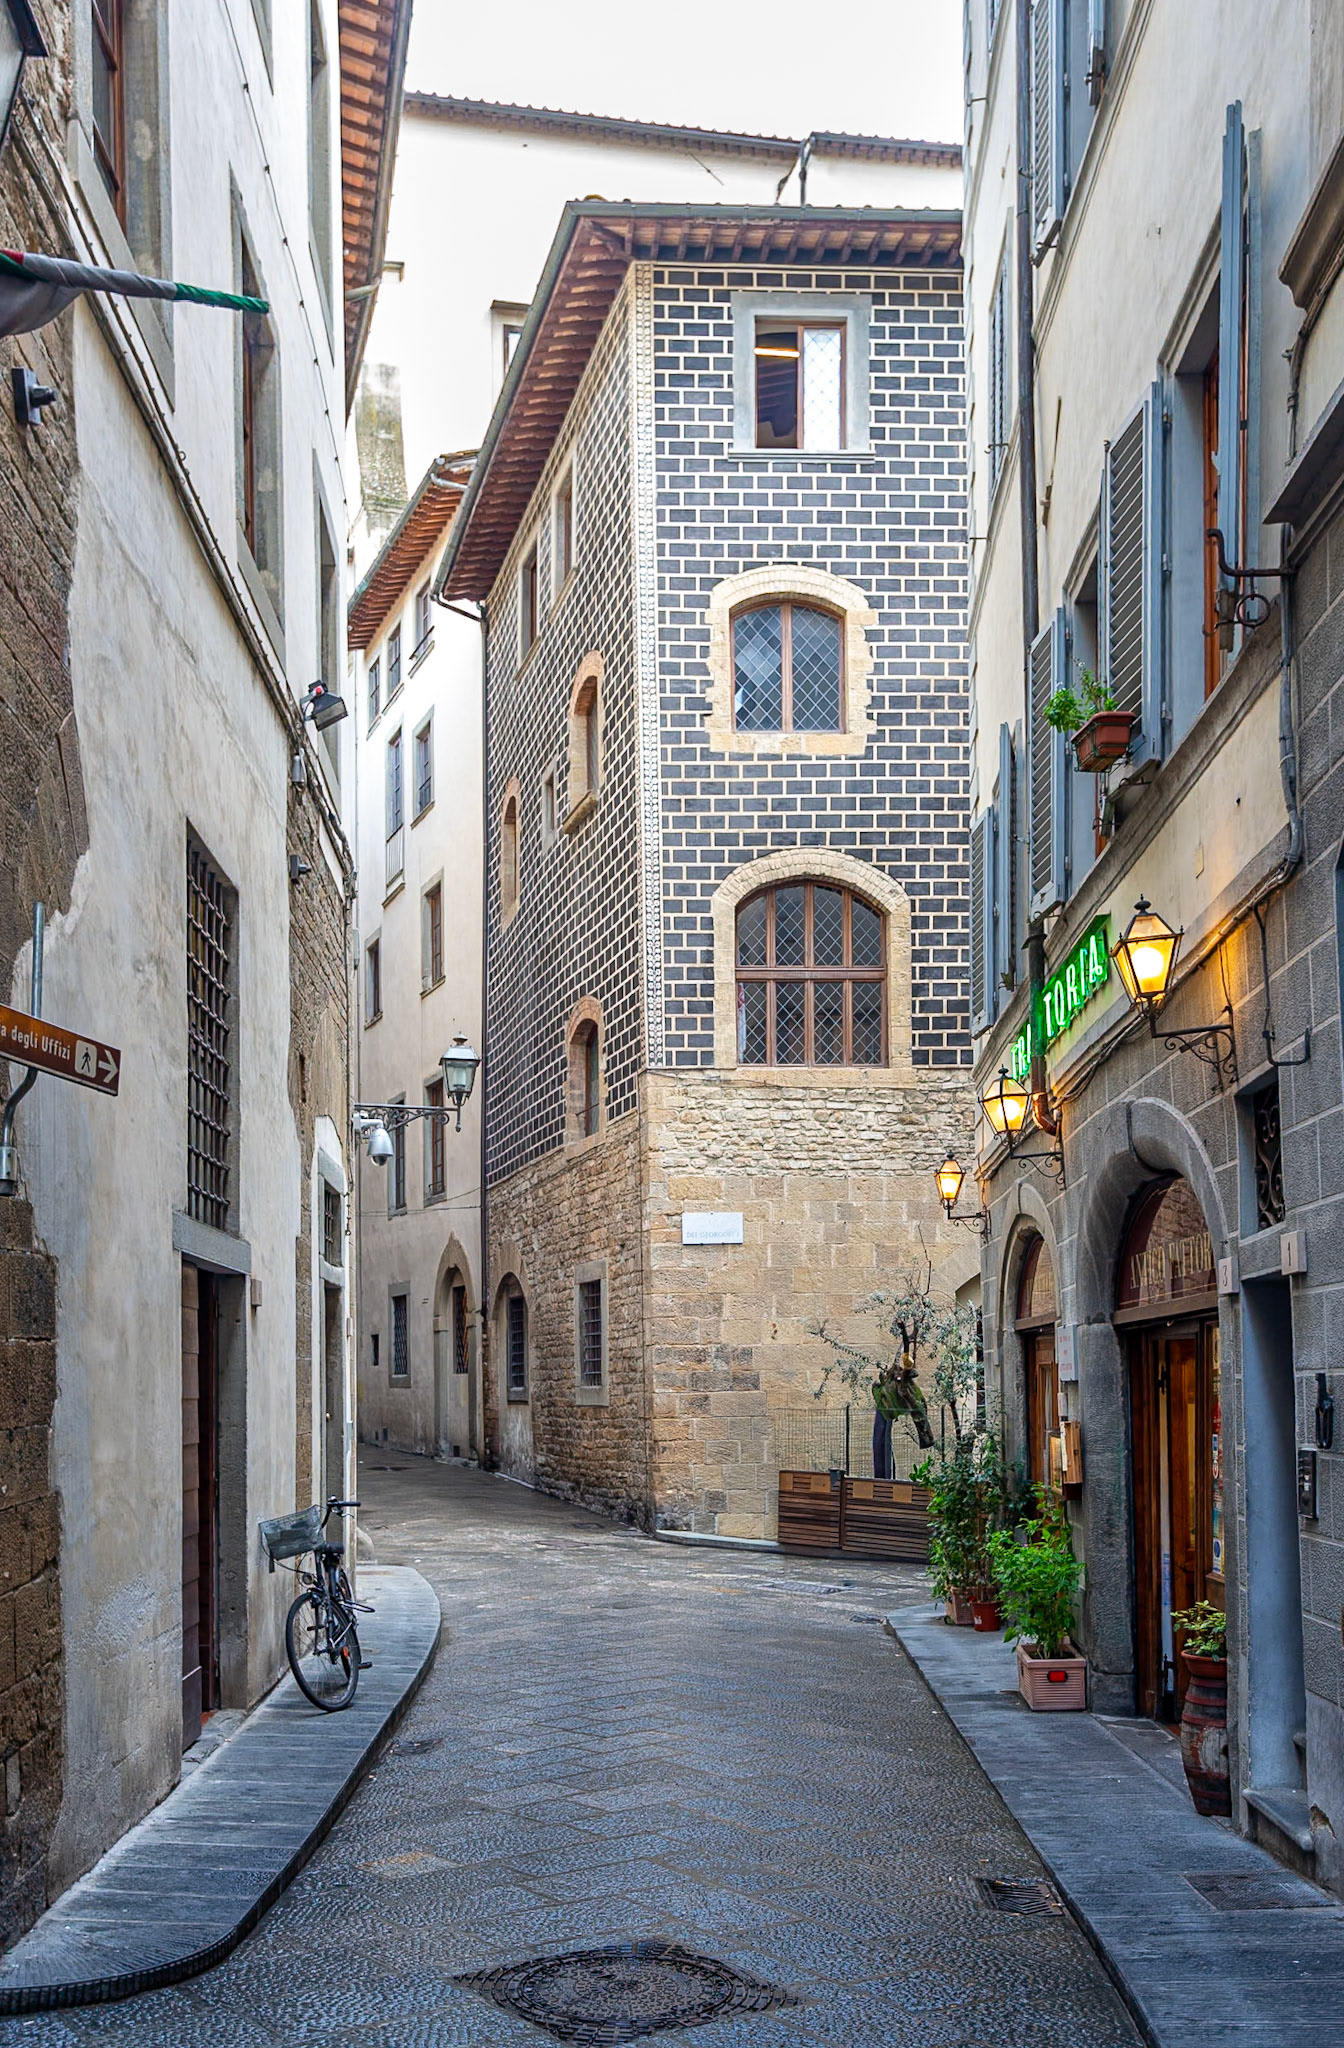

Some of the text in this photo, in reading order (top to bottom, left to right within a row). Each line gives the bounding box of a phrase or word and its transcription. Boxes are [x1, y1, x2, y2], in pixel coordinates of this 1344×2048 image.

[1010, 935, 1103, 1080] TRTORIA
[11, 1025, 38, 1049] degli
[41, 1036, 71, 1060] Uffizi
[1168, 1233, 1212, 1279] FATTOR
[1286, 1241, 1292, 1267] 1
[1222, 1265, 1228, 1287] 3
